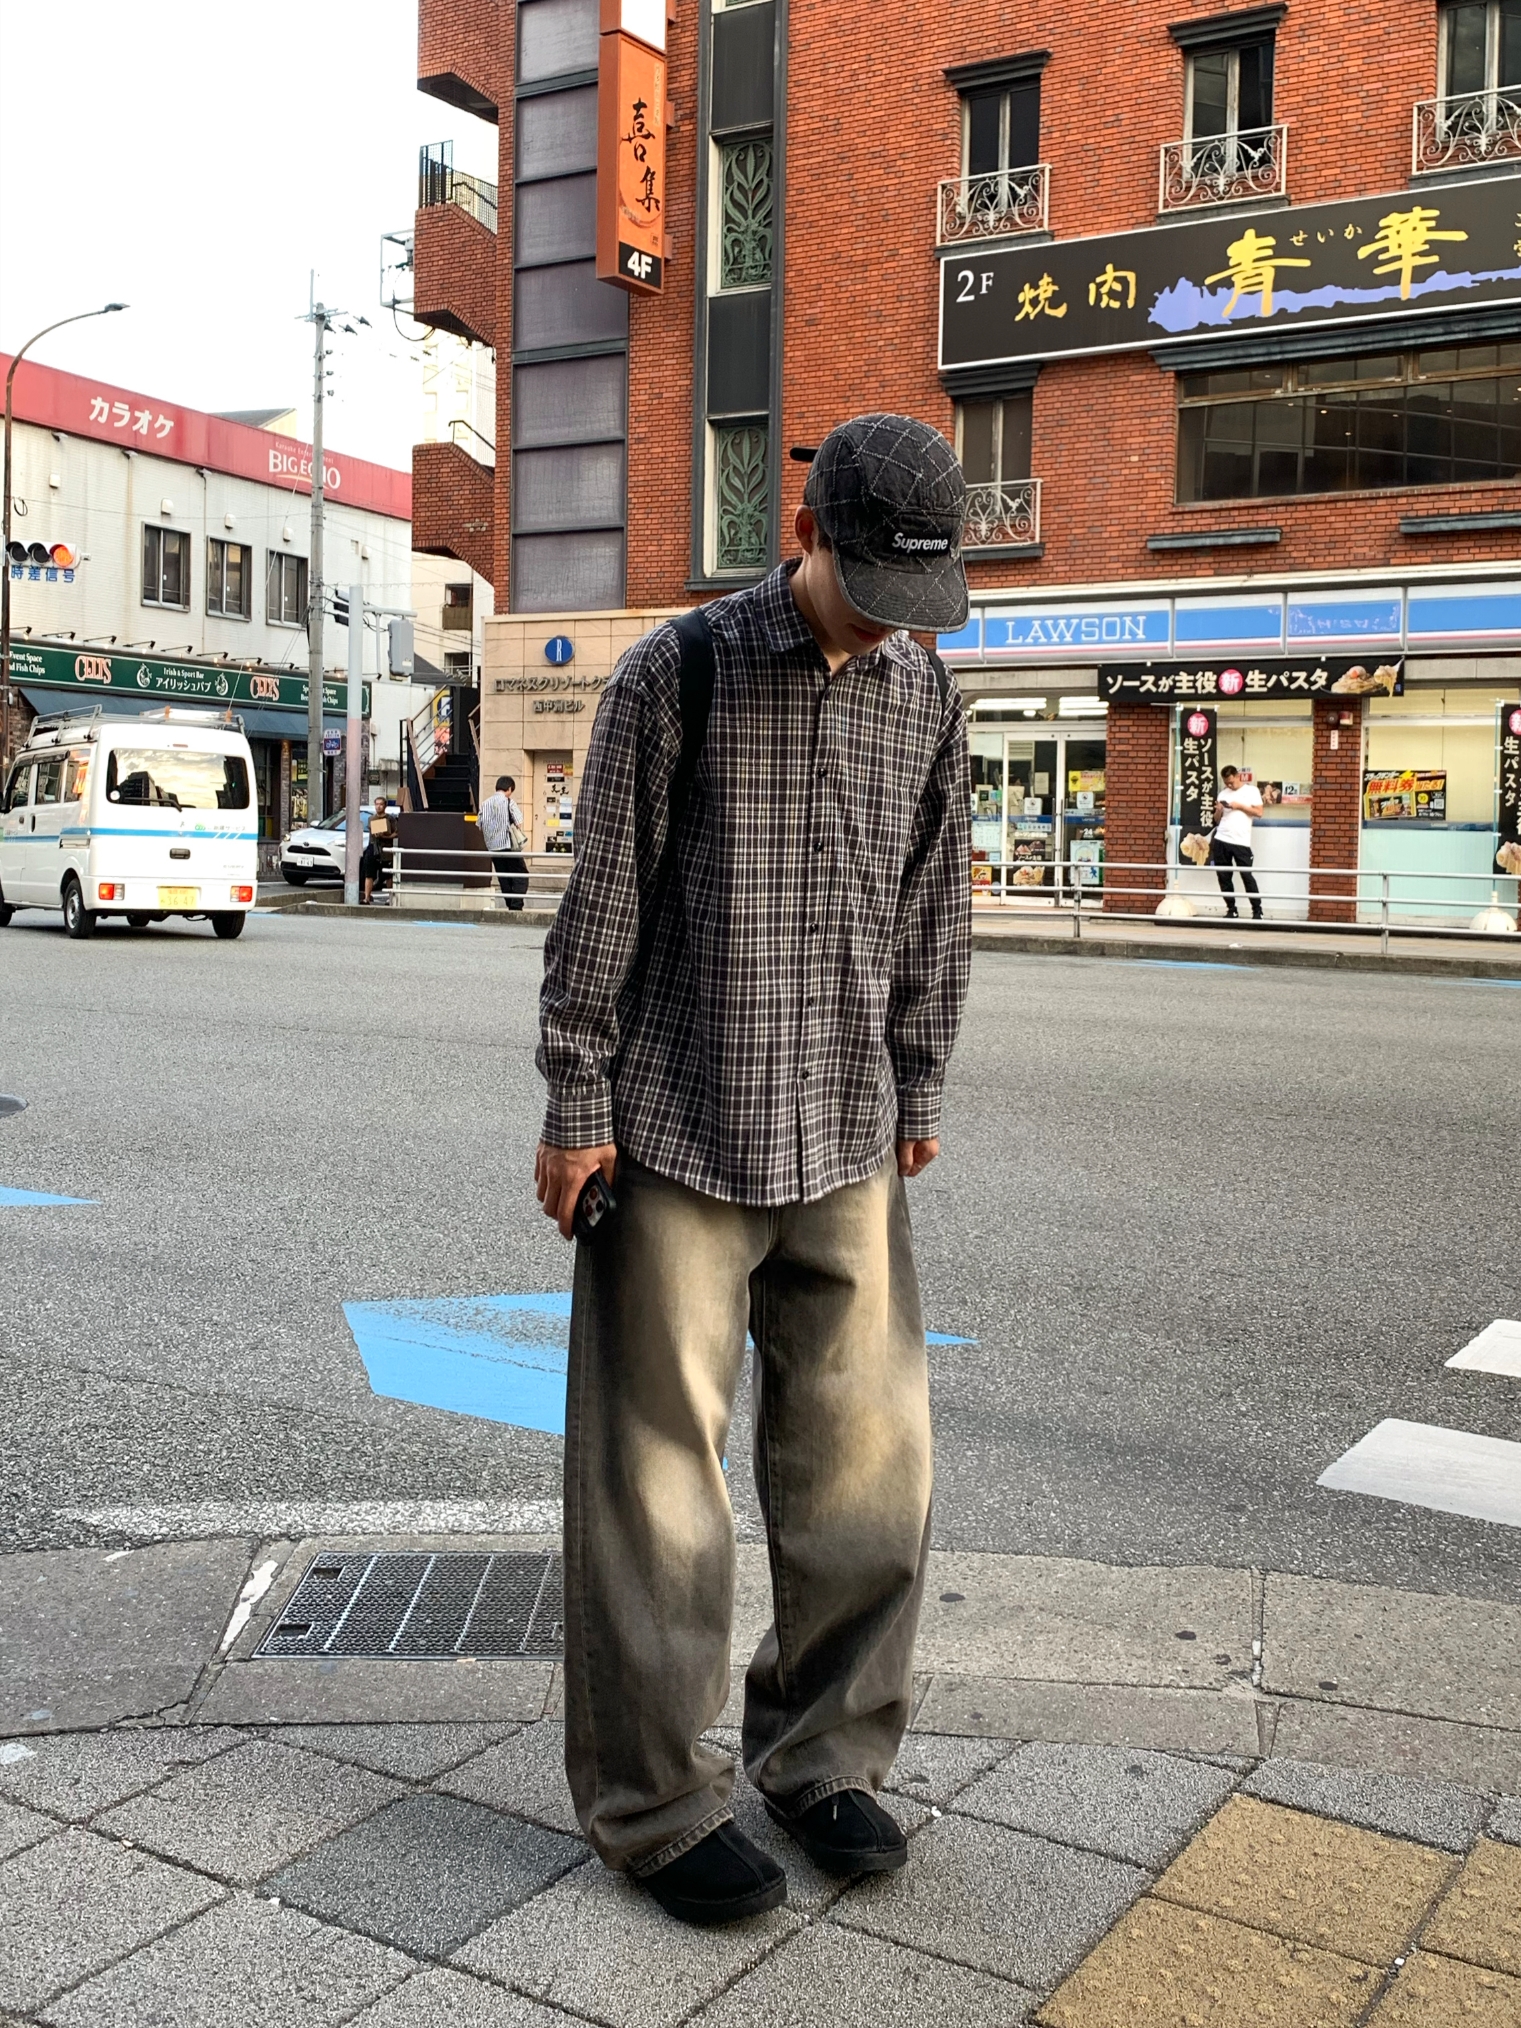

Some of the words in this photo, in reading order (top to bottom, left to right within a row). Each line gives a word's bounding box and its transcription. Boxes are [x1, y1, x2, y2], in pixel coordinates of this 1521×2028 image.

[1290, 223, 1363, 246] せいか
[627, 251, 653, 279] 4F
[956, 269, 994, 303] 2F
[1014, 263, 1136, 322] 焼肉
[89, 396, 175, 438] カラオケ
[892, 532, 948, 553] Supreme
[11, 564, 75, 583] 時差信号
[1005, 615, 1147, 644] LAWSON
[26, 653, 43, 663] Space
[556, 638, 563, 662] R
[16, 663, 28, 673] Fish
[29, 664, 46, 676] Chips
[75, 655, 112, 684] CELTS
[163, 667, 177, 676] Irish
[181, 669, 195, 679] Sport
[195, 671, 205, 679] Bar
[155, 677, 212, 693] アイリッシュパブ
[250, 676, 280, 701] CELTS
[1190, 717, 1206, 734] 新
[1183, 737, 1200, 802] 生パスタ
[1503, 735, 1520, 807] 生パスタ
[1199, 738, 1214, 828] ソースが主役
[1367, 778, 1415, 794] 無料券
